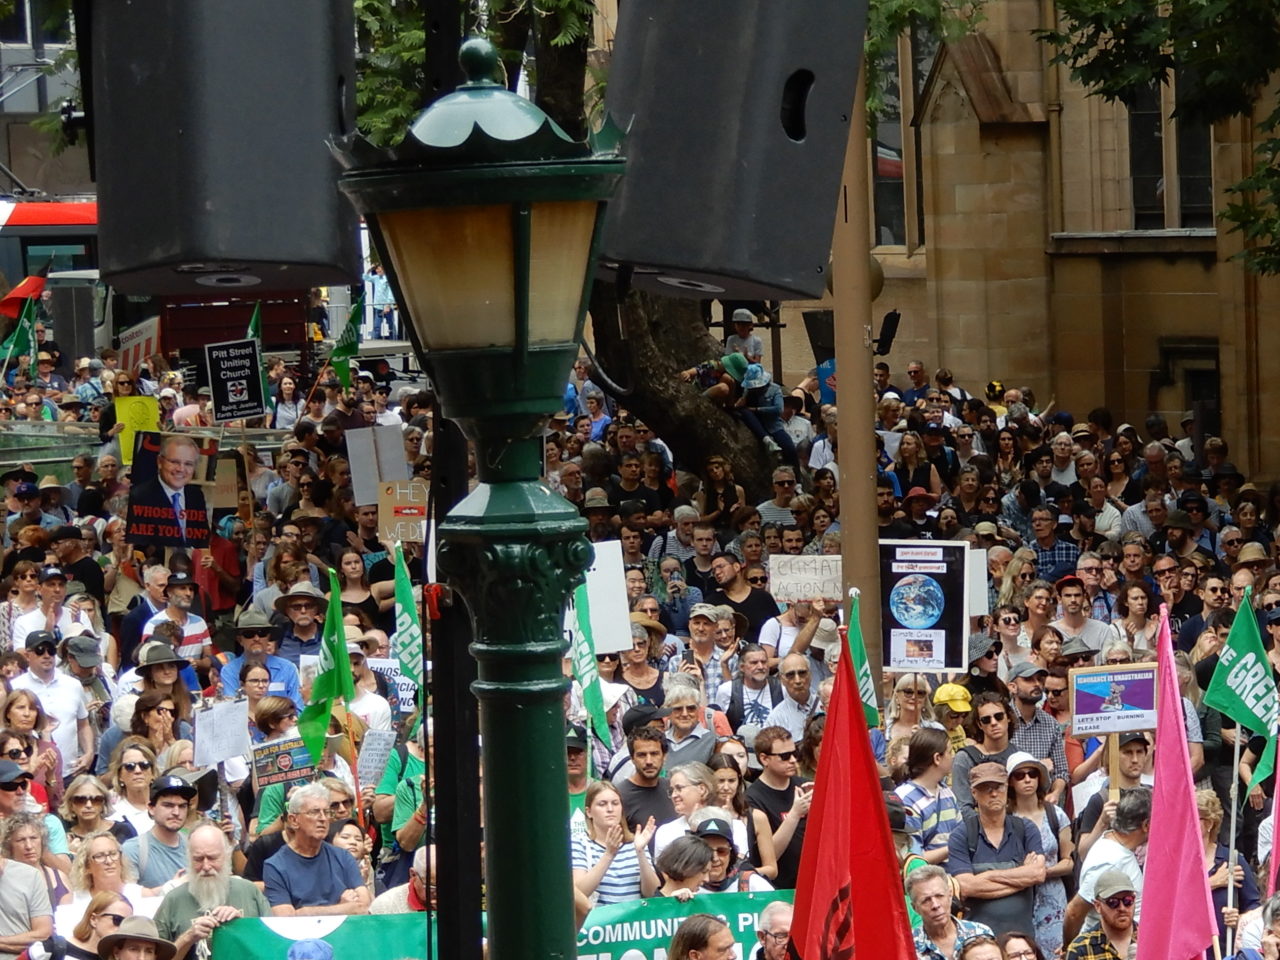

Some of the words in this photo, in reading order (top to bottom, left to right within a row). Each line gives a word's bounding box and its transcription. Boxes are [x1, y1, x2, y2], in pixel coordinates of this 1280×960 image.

[212, 350, 228, 359] Pitt
[229, 347, 253, 357] Street
[220, 359, 250, 368] Uniting
[220, 368, 251, 379] Church
[397, 482, 430, 502] HEY
[132, 505, 176, 519] WHOSE
[179, 509, 206, 522] SIDE
[129, 523, 154, 535] ARE
[158, 525, 182, 537] YOU
[185, 528, 208, 539] ON?
[777, 558, 842, 577] CLIMAT
[777, 581, 826, 594] ACTION
[1226, 652, 1279, 737] GREEN
[576, 916, 689, 947] COMMUNIT
